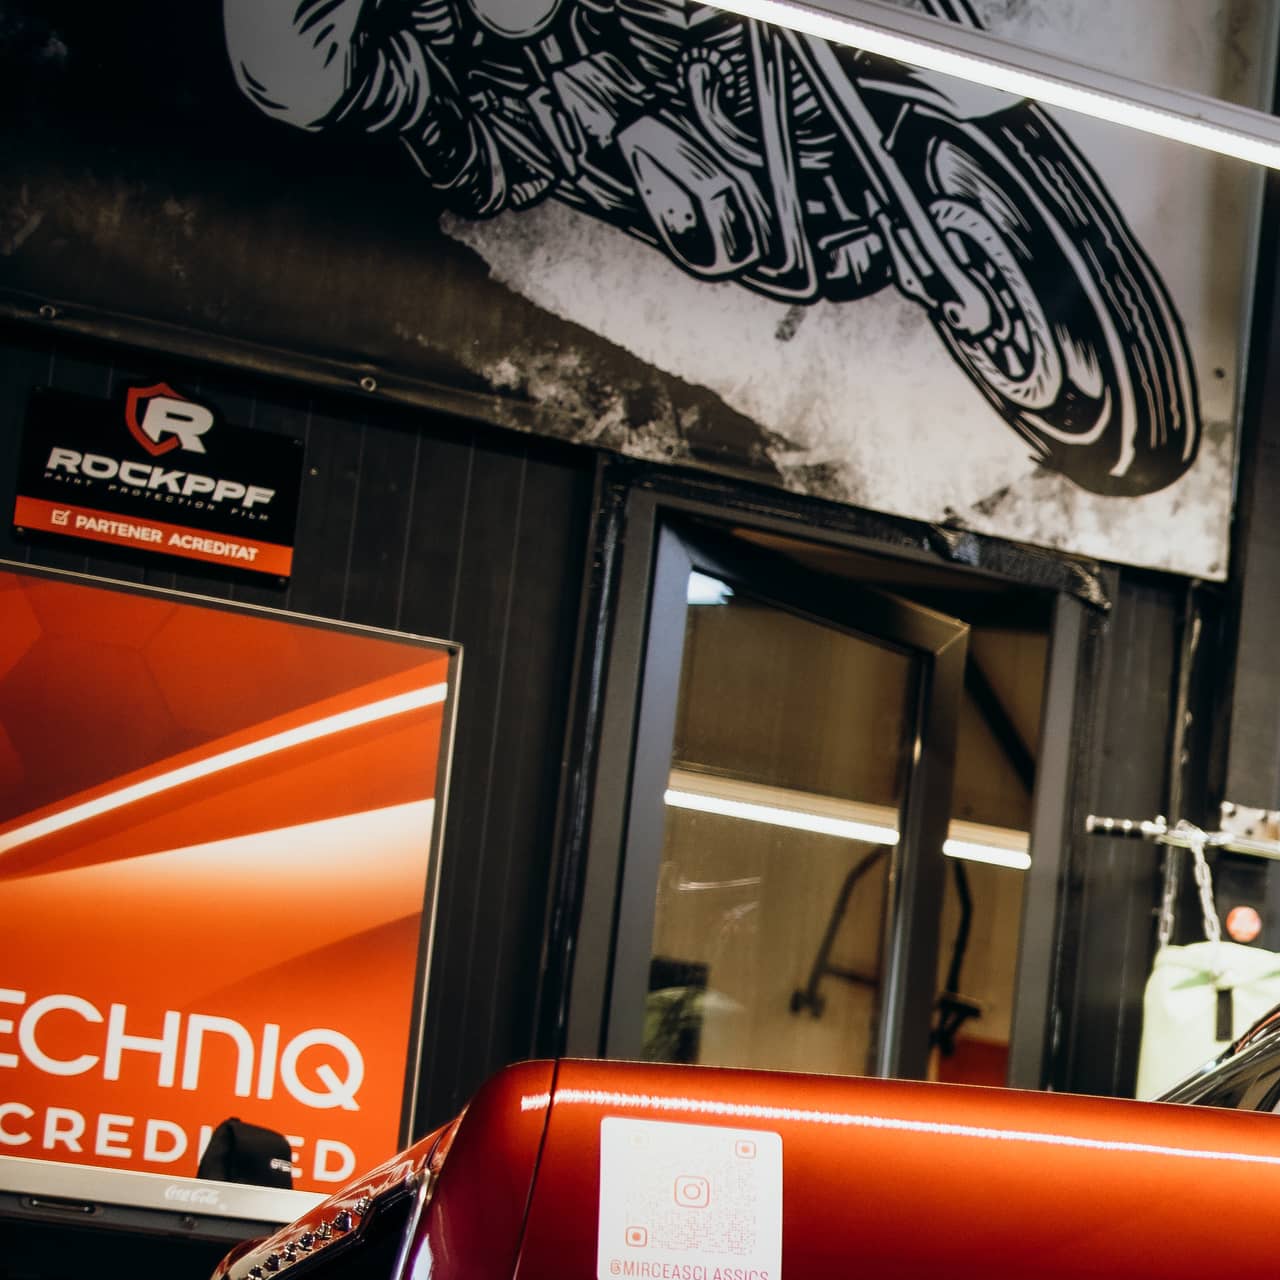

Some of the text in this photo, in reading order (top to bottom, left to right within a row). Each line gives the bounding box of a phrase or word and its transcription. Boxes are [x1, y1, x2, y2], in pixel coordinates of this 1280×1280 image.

[44, 473, 269, 521] PAINT PROTECTION FILM
[47, 447, 275, 508] ROCKPPF
[75, 515, 258, 561] PARTENER ACREDITAT
